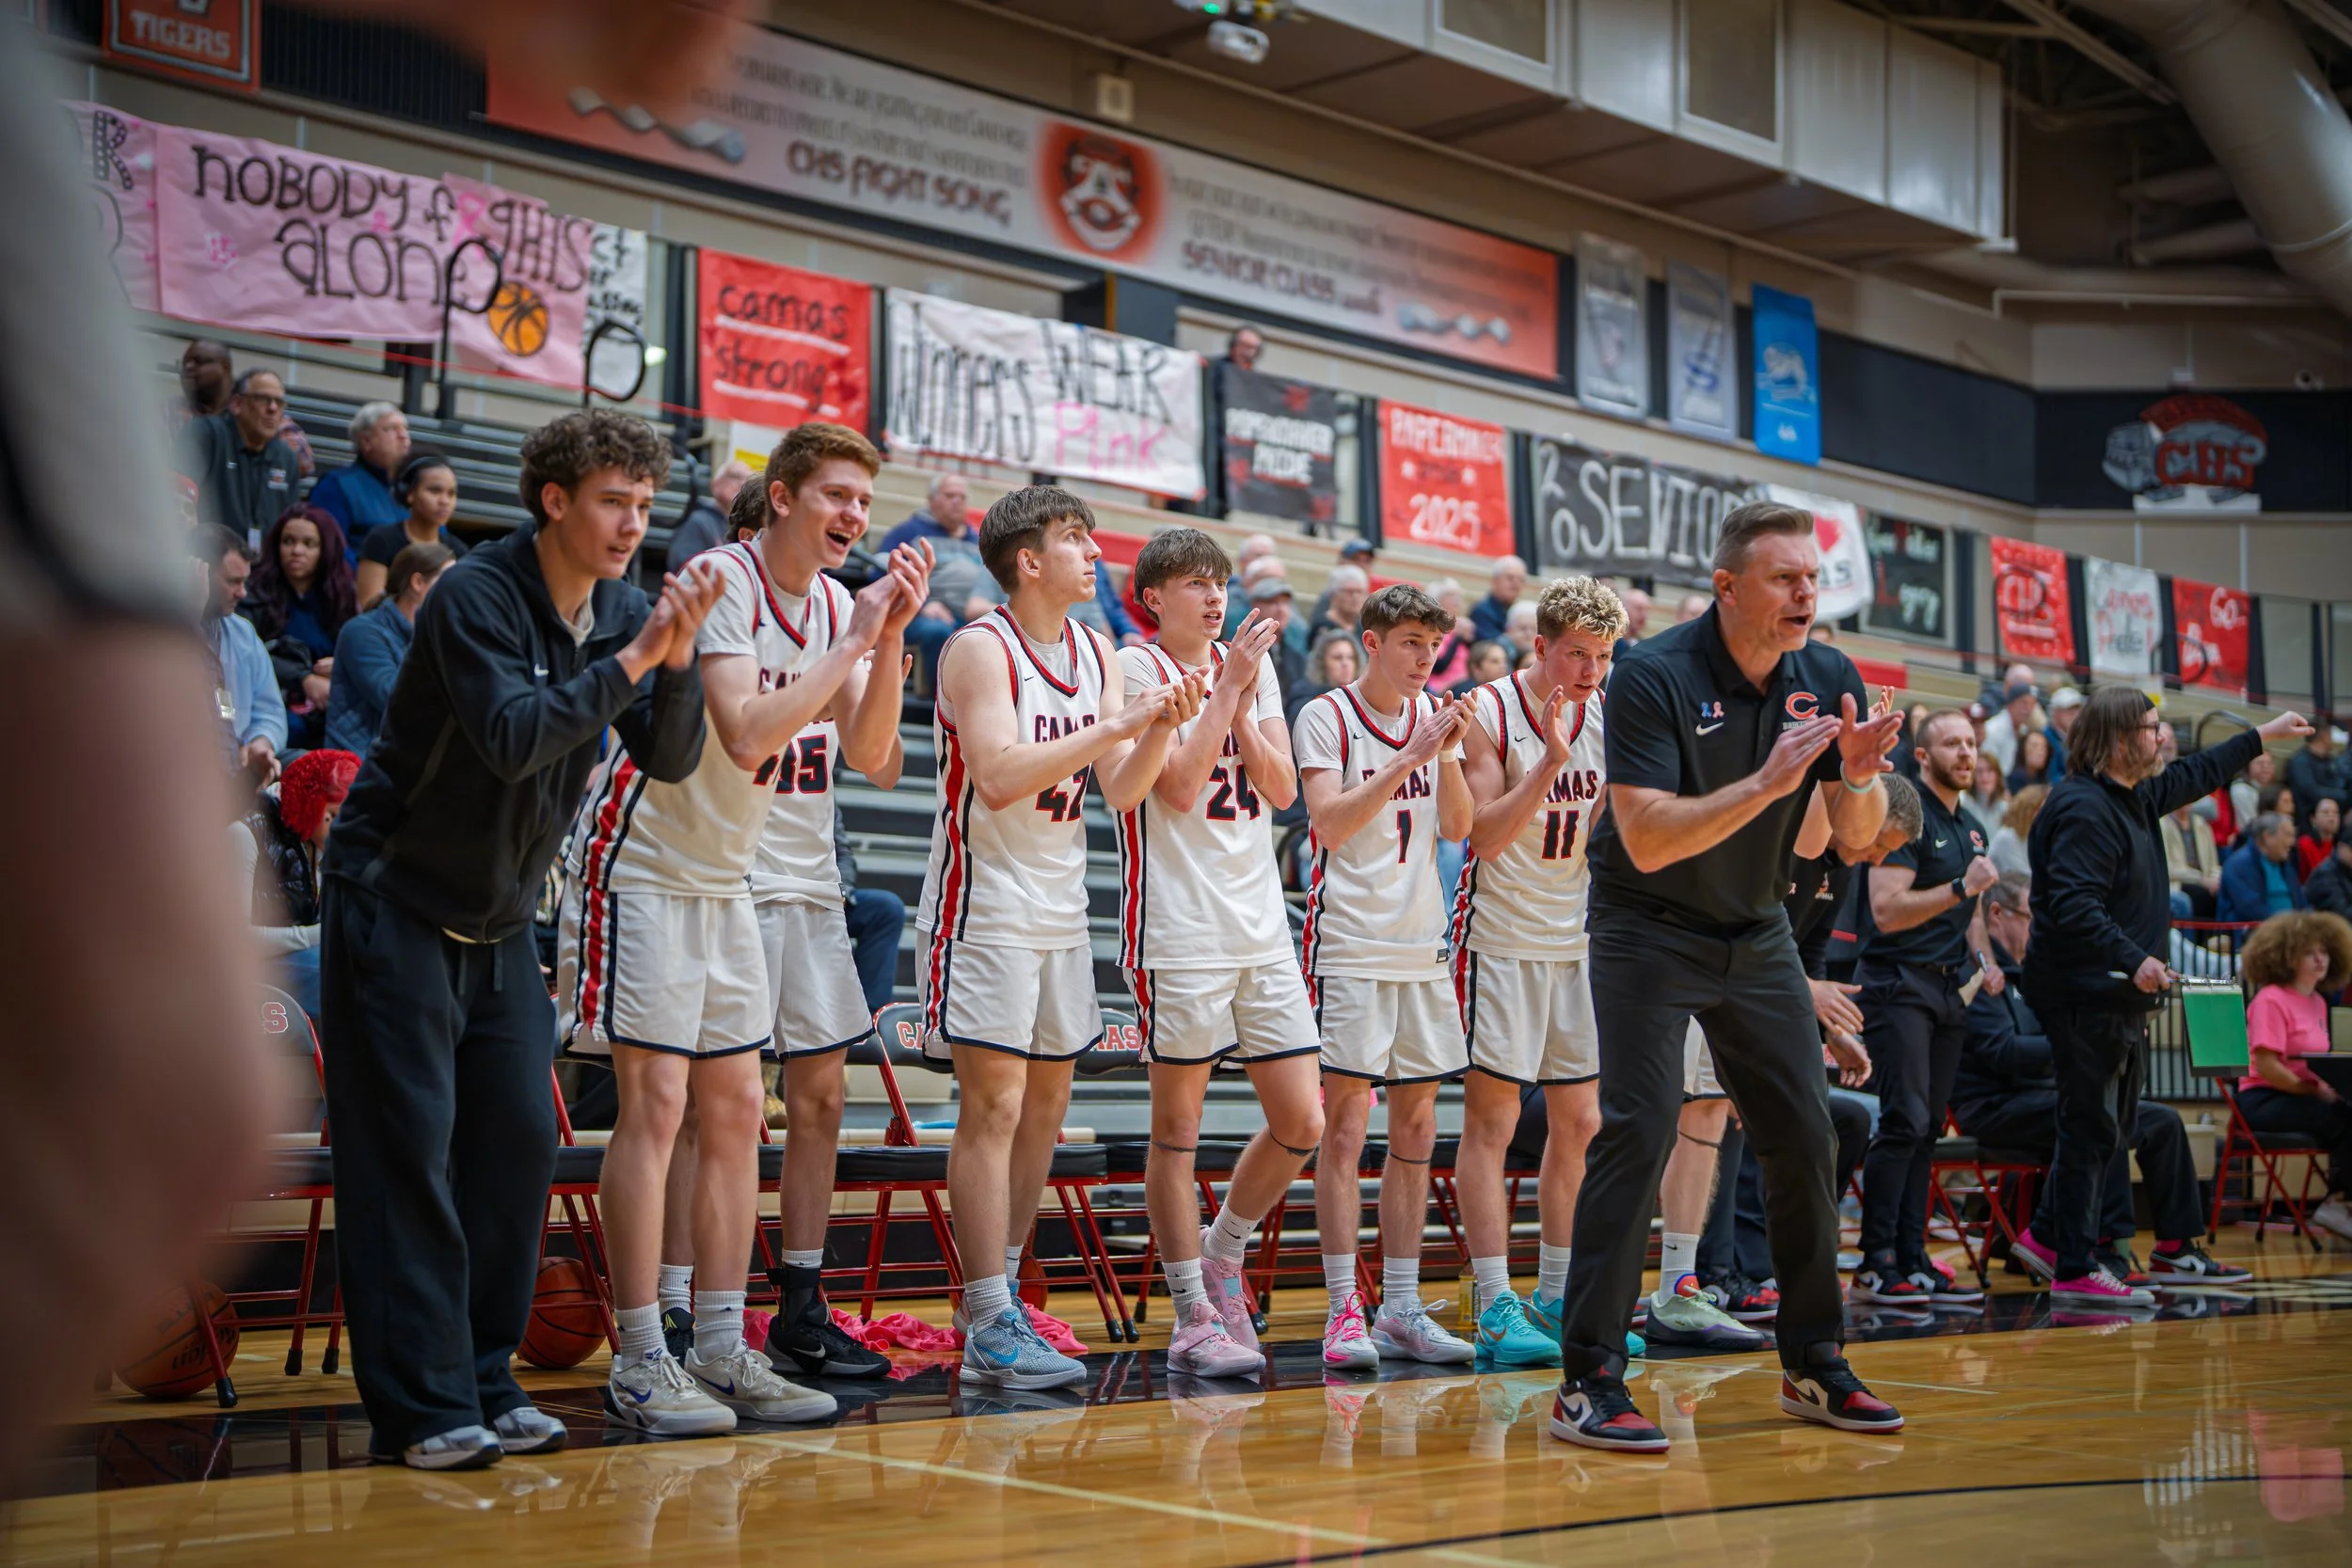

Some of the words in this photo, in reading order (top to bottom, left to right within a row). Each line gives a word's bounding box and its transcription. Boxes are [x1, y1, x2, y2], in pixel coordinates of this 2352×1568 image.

[130, 9, 231, 60] TIGERS
[2155, 438, 2257, 491] CHS
[1409, 492, 1481, 550] 2025
[1785, 691, 1820, 721] C
[1206, 763, 1261, 821] 24
[1396, 809, 1412, 863] 1
[1541, 809, 1580, 860] 11
